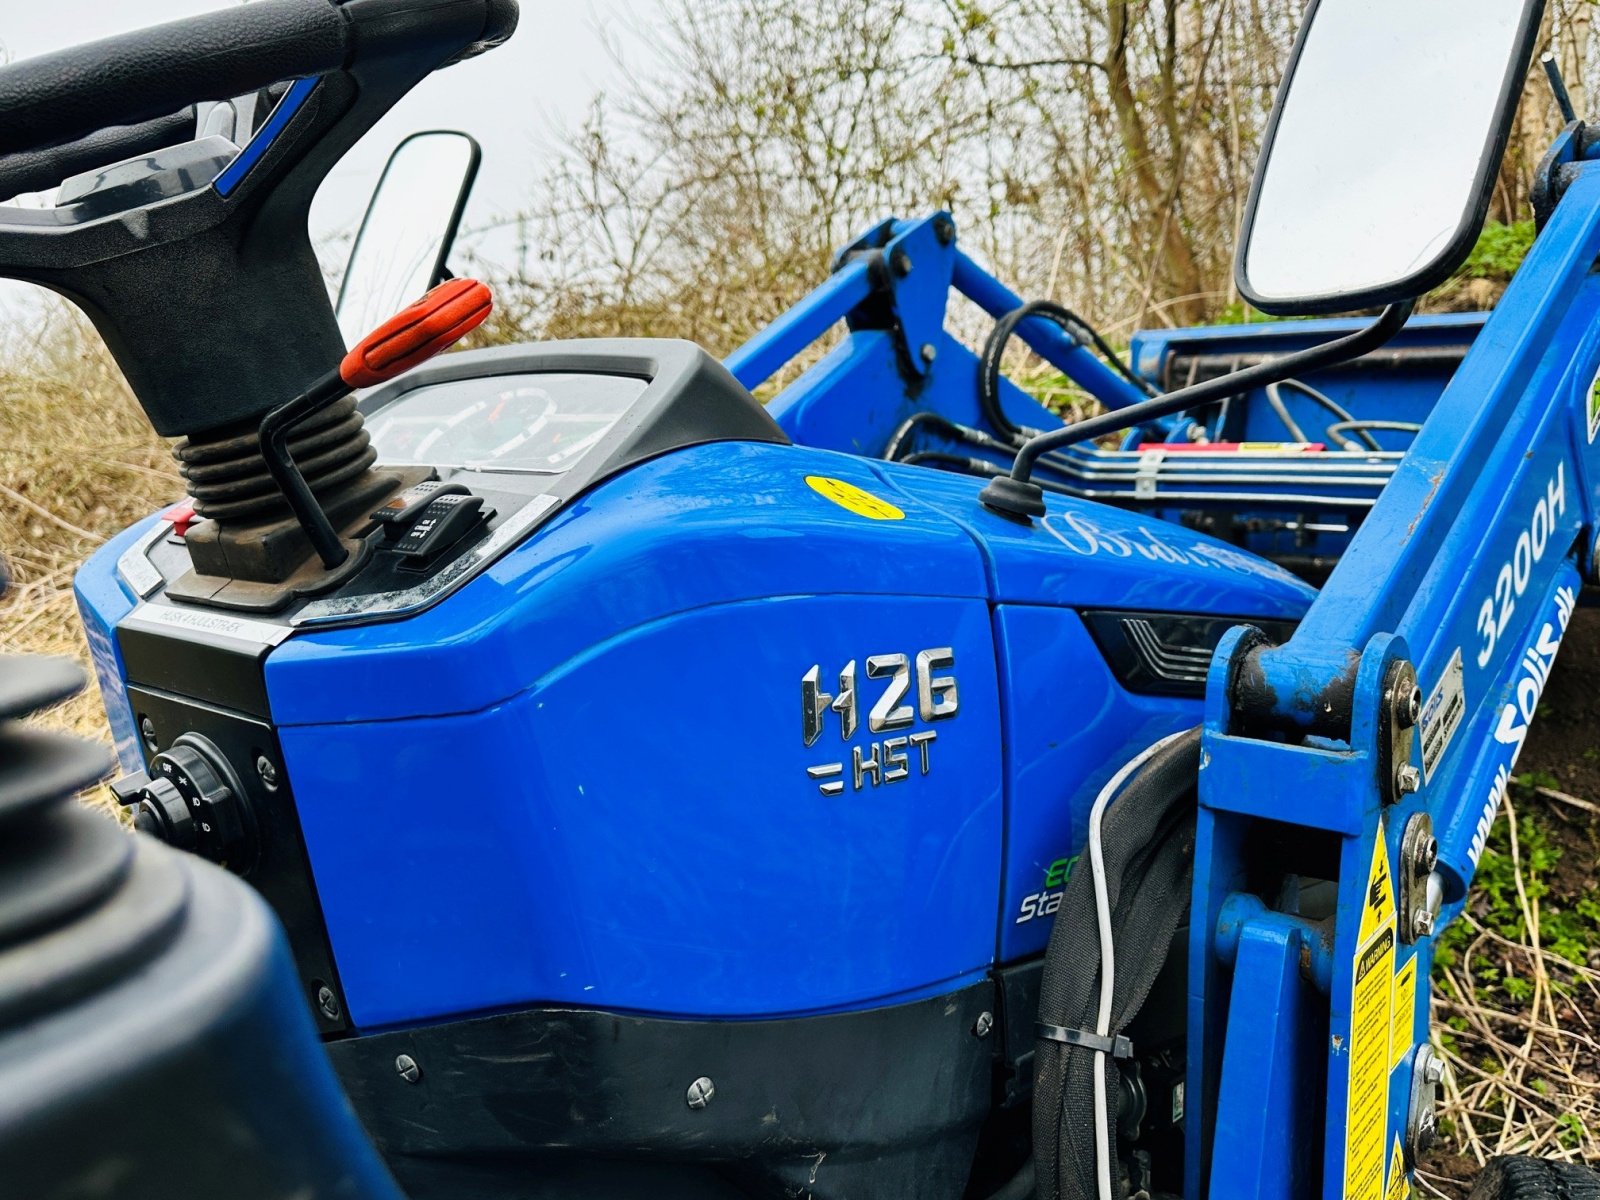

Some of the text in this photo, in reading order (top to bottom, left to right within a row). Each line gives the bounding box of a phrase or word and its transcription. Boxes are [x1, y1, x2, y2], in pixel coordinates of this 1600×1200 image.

[1477, 458, 1566, 670] 3200H
[801, 646, 959, 747] H26
[853, 729, 937, 790] HST
[1015, 890, 1064, 924] Sta
[1365, 935, 1391, 970] WARNING
